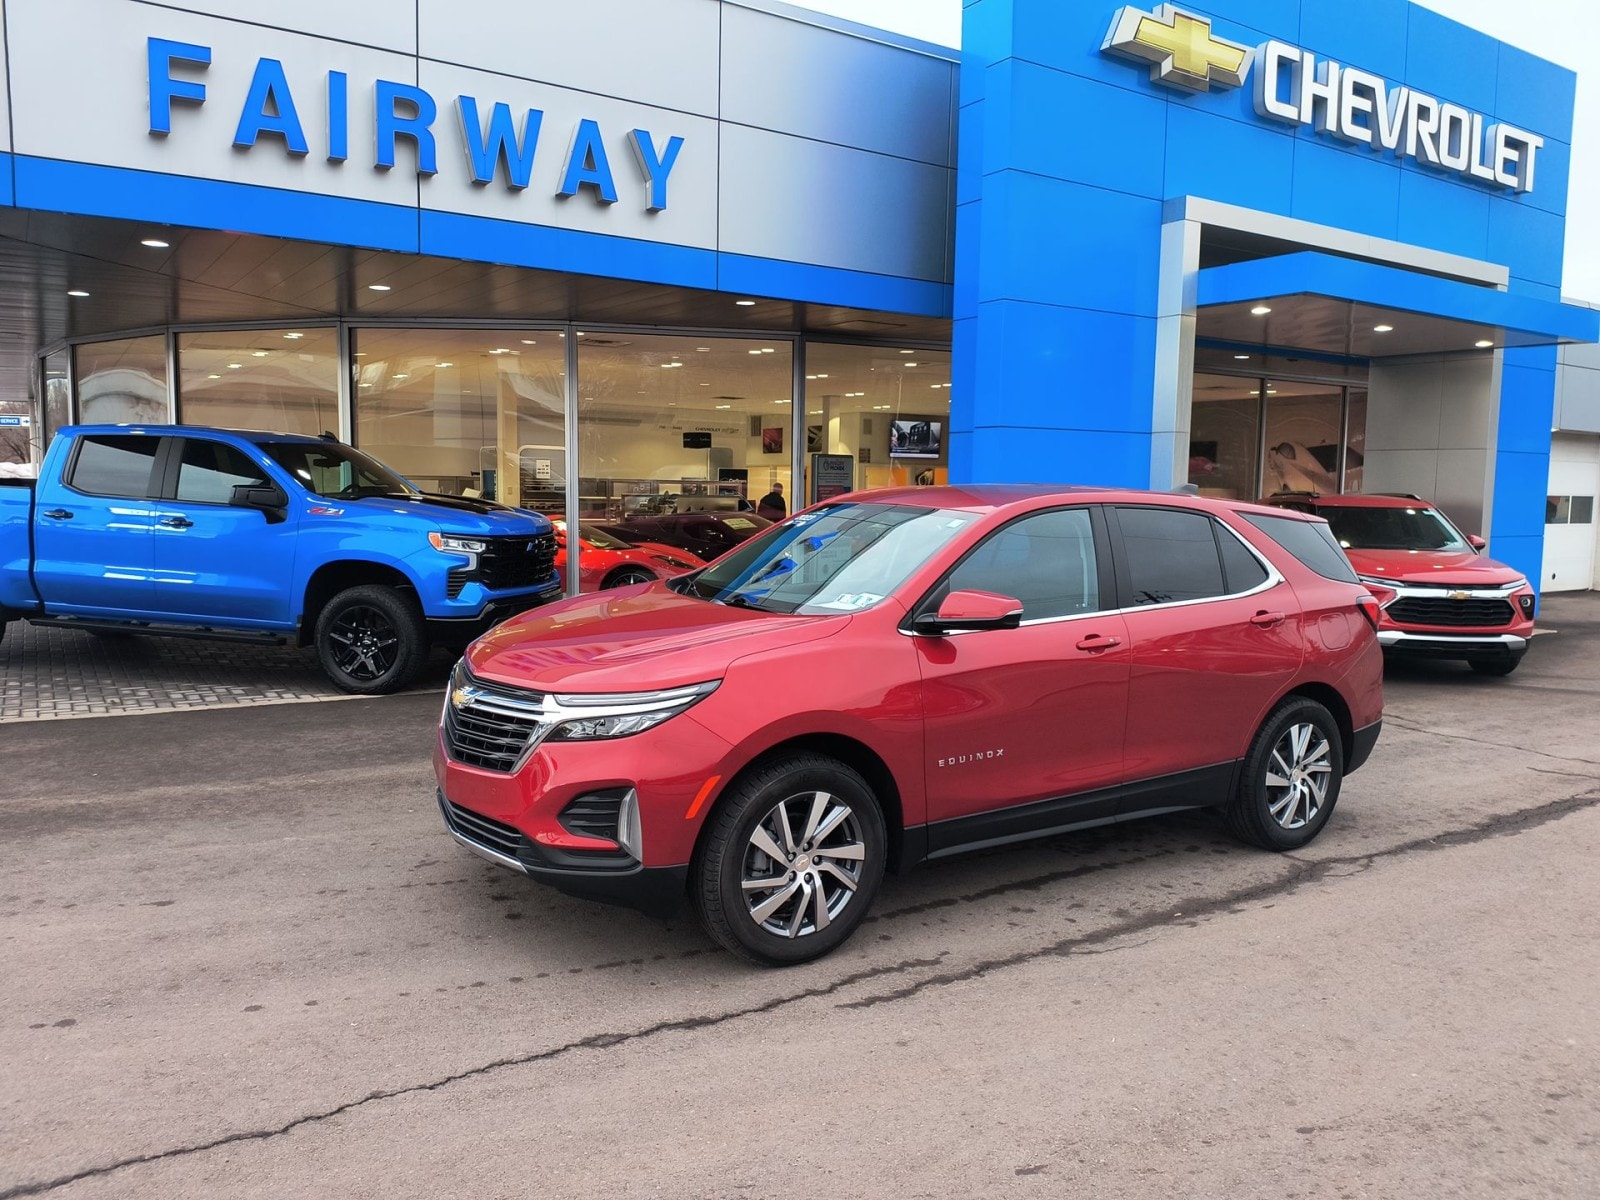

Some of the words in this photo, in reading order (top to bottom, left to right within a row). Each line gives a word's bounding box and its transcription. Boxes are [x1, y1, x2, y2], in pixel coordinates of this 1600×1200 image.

[146, 37, 685, 213] FAIRWAY
[1253, 40, 1544, 194] CHEVROLET
[938, 748, 1004, 767] EQUINOX
